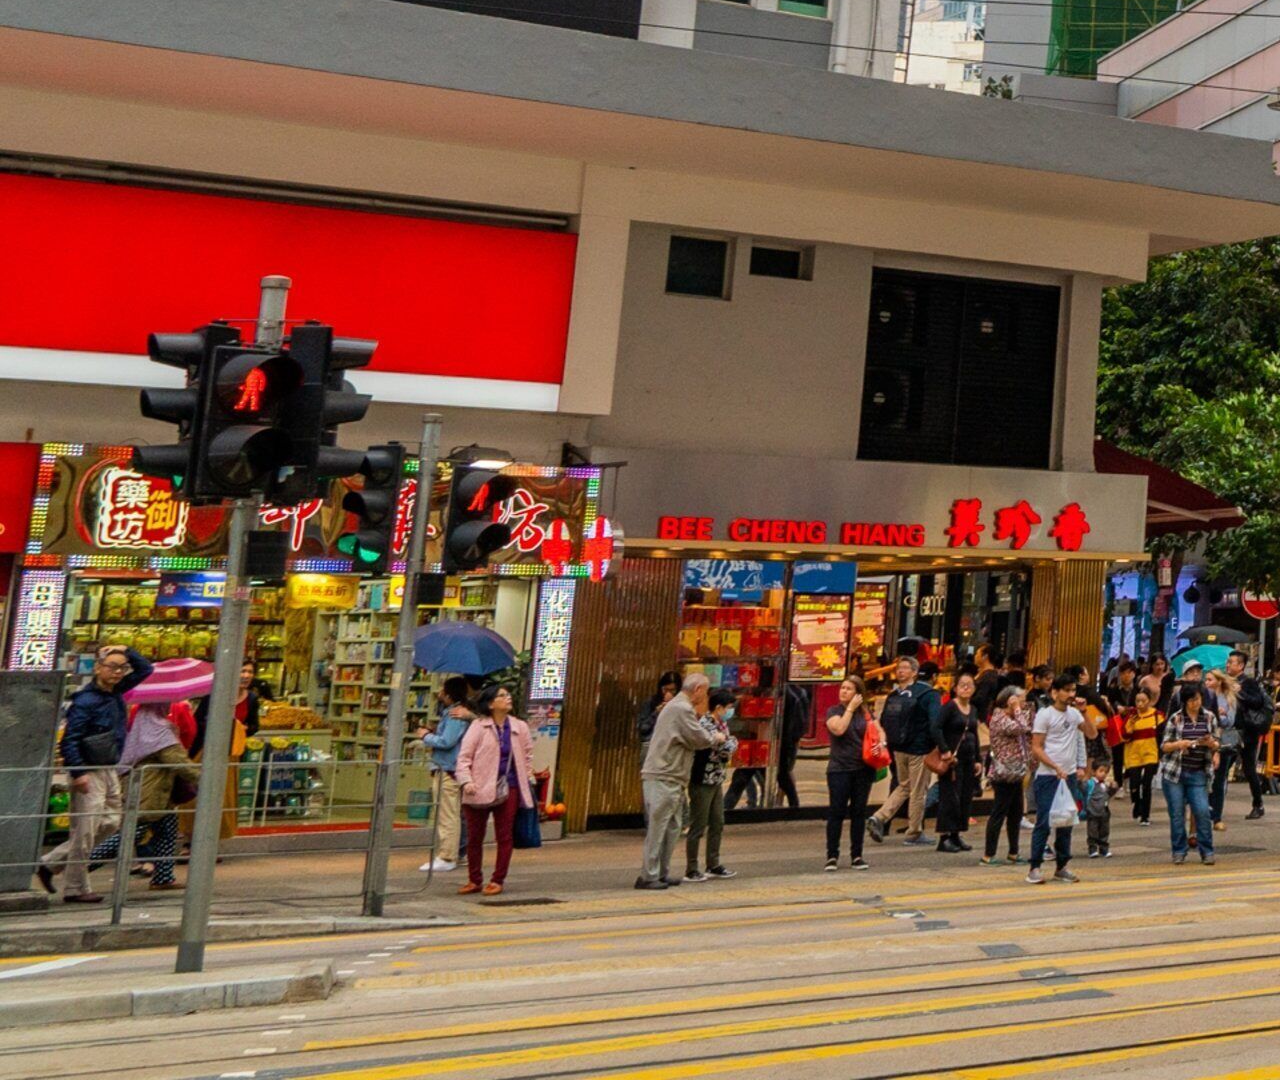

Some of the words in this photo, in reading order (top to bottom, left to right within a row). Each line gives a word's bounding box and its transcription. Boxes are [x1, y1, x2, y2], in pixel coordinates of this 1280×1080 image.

[657, 516, 713, 541] BEE
[728, 518, 827, 545] CHENG
[840, 522, 925, 547] HIANG
